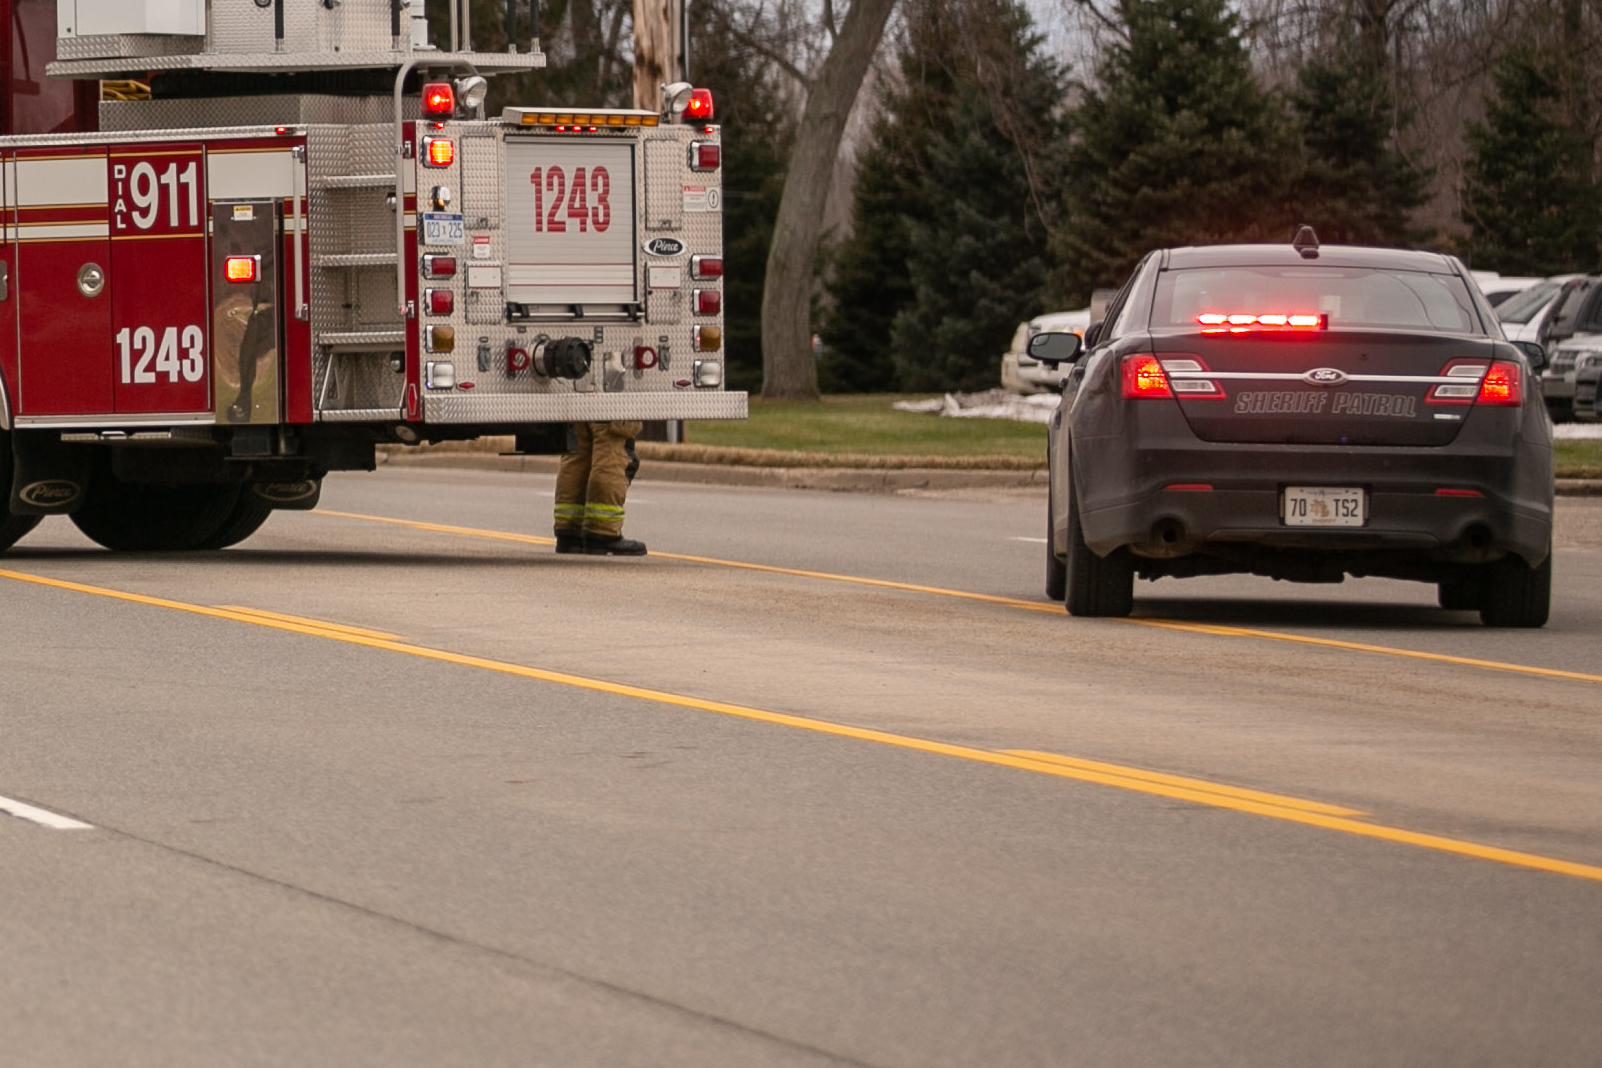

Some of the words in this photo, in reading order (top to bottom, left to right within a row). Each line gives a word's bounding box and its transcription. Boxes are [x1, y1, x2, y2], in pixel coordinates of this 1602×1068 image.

[114, 164, 127, 229] DIAL
[130, 161, 199, 230] 911
[530, 165, 611, 233] 1243
[116, 325, 204, 384] 1243
[1234, 391, 1328, 414] SHERIFF
[1331, 392, 1416, 418] PATROL
[1290, 498, 1307, 517] 70
[1333, 498, 1359, 518] TS2
